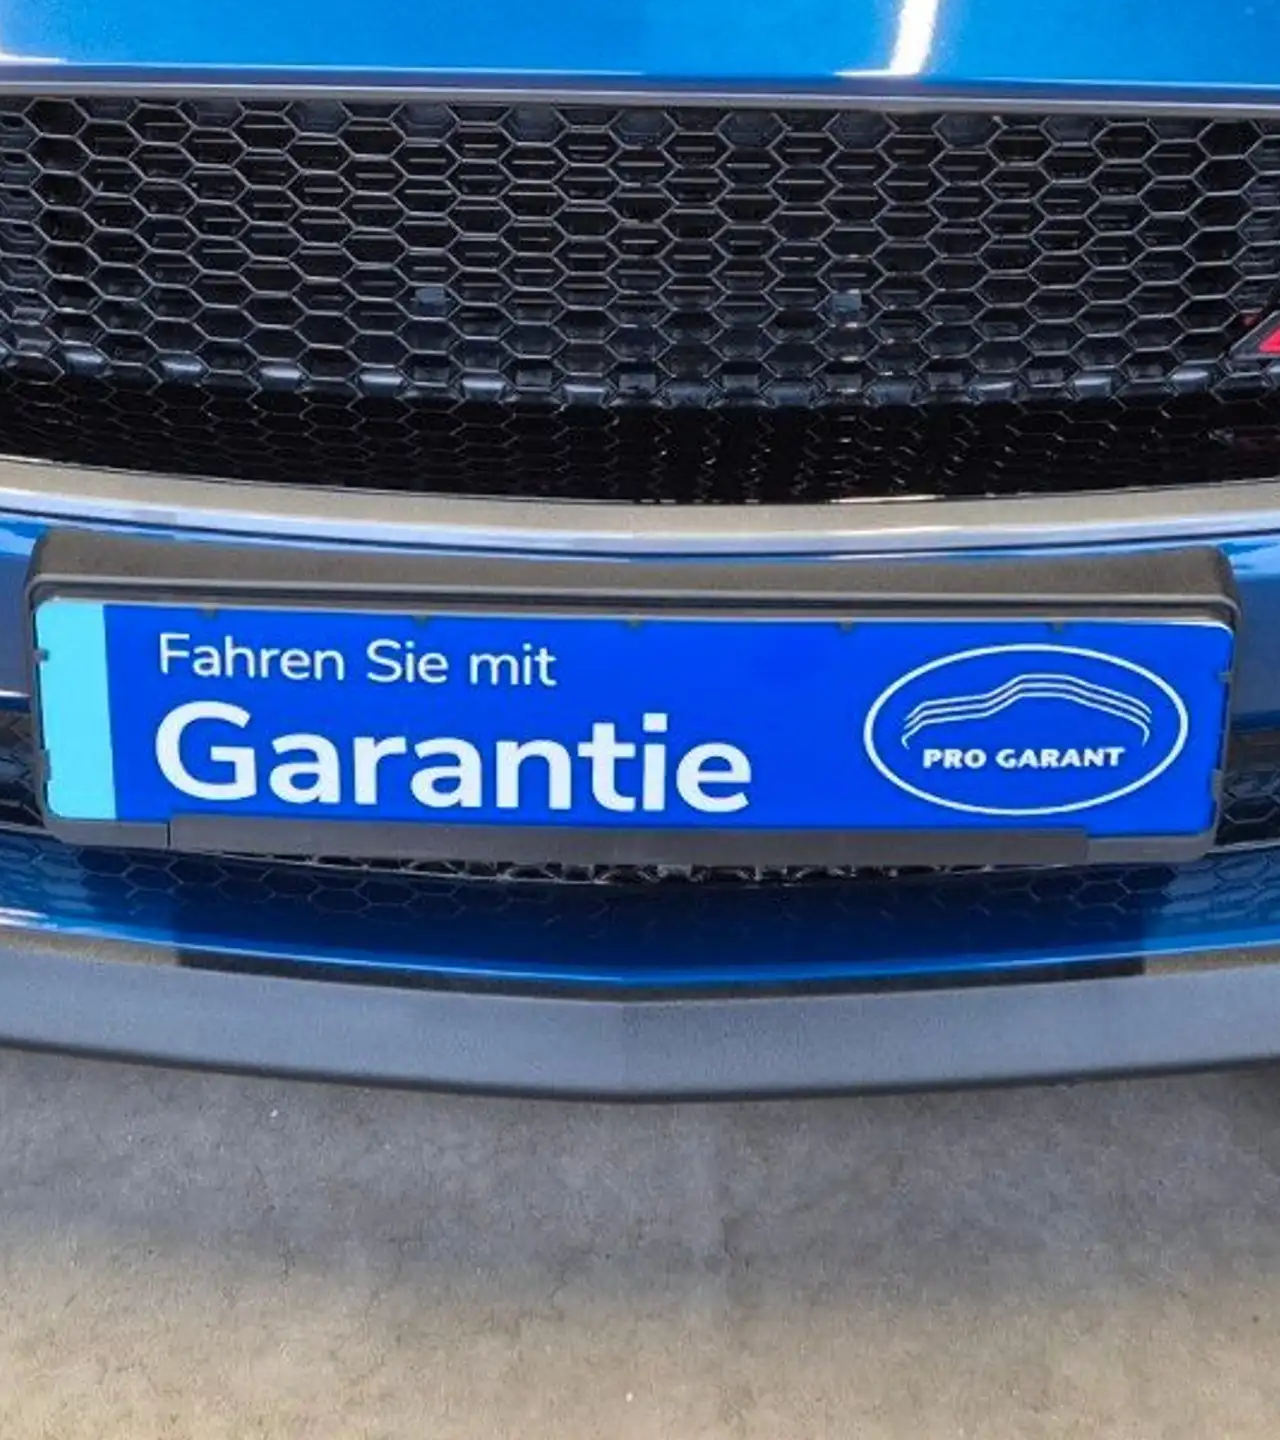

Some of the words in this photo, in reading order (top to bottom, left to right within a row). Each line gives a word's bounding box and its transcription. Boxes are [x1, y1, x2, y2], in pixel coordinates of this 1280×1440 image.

[159, 633, 344, 680] Fahren
[366, 639, 448, 683] Sie
[470, 643, 556, 686] mit
[155, 701, 751, 812] Garantie
[923, 748, 987, 769] PRO
[995, 747, 1125, 769] GARANT
